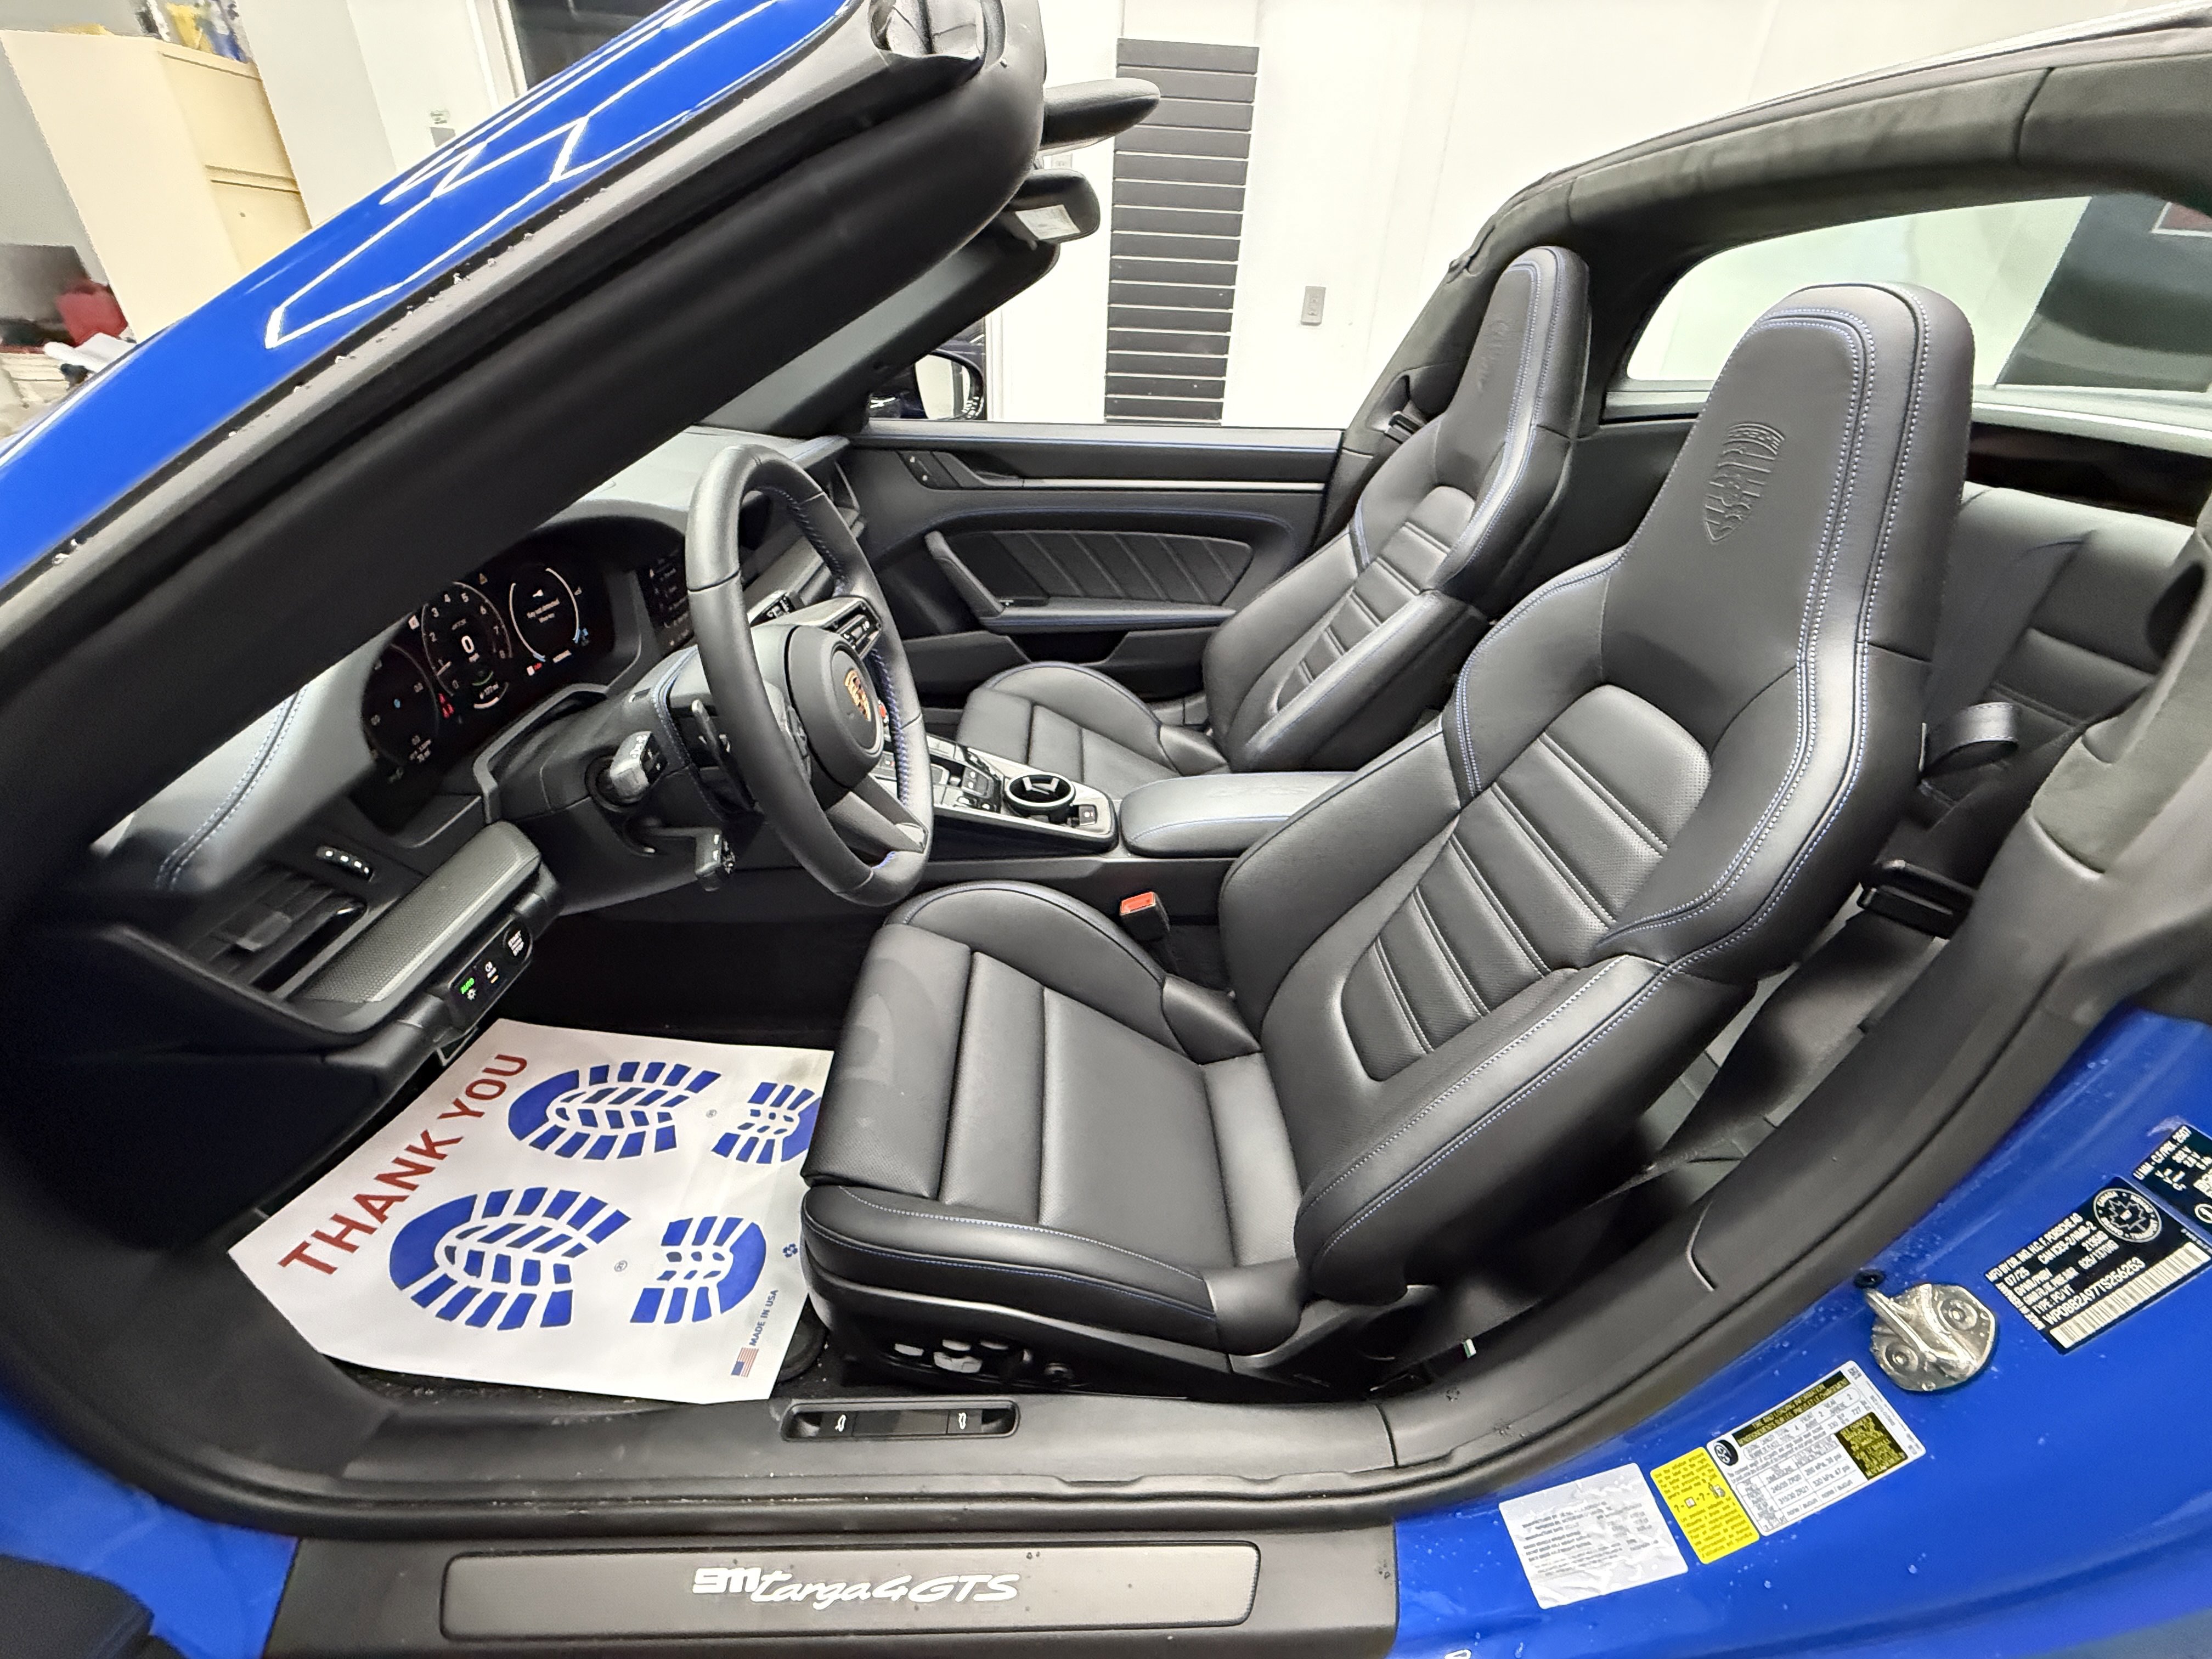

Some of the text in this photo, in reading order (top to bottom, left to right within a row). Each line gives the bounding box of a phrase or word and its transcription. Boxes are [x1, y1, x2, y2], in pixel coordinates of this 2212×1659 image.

[461, 592, 469, 602] 5
[480, 605, 487, 615] 6
[431, 607, 439, 618] 3
[429, 632, 437, 642] 2
[461, 635, 475, 653] 0
[277, 1053, 528, 1276] THANK YOU
[1985, 1267, 2004, 1283] MFD
[1997, 1261, 2012, 1274] BY
[2042, 1217, 2076, 1244] PORSCHE
[2067, 1211, 2084, 1225] AG
[2002, 1265, 2032, 1288] 07/25
[2036, 1248, 2057, 1266] CAN
[749, 1289, 778, 1346] MADE IN USA
[692, 1567, 761, 1593] 911
[870, 1575, 912, 1601] 4
[907, 1573, 1020, 1602] GTS
